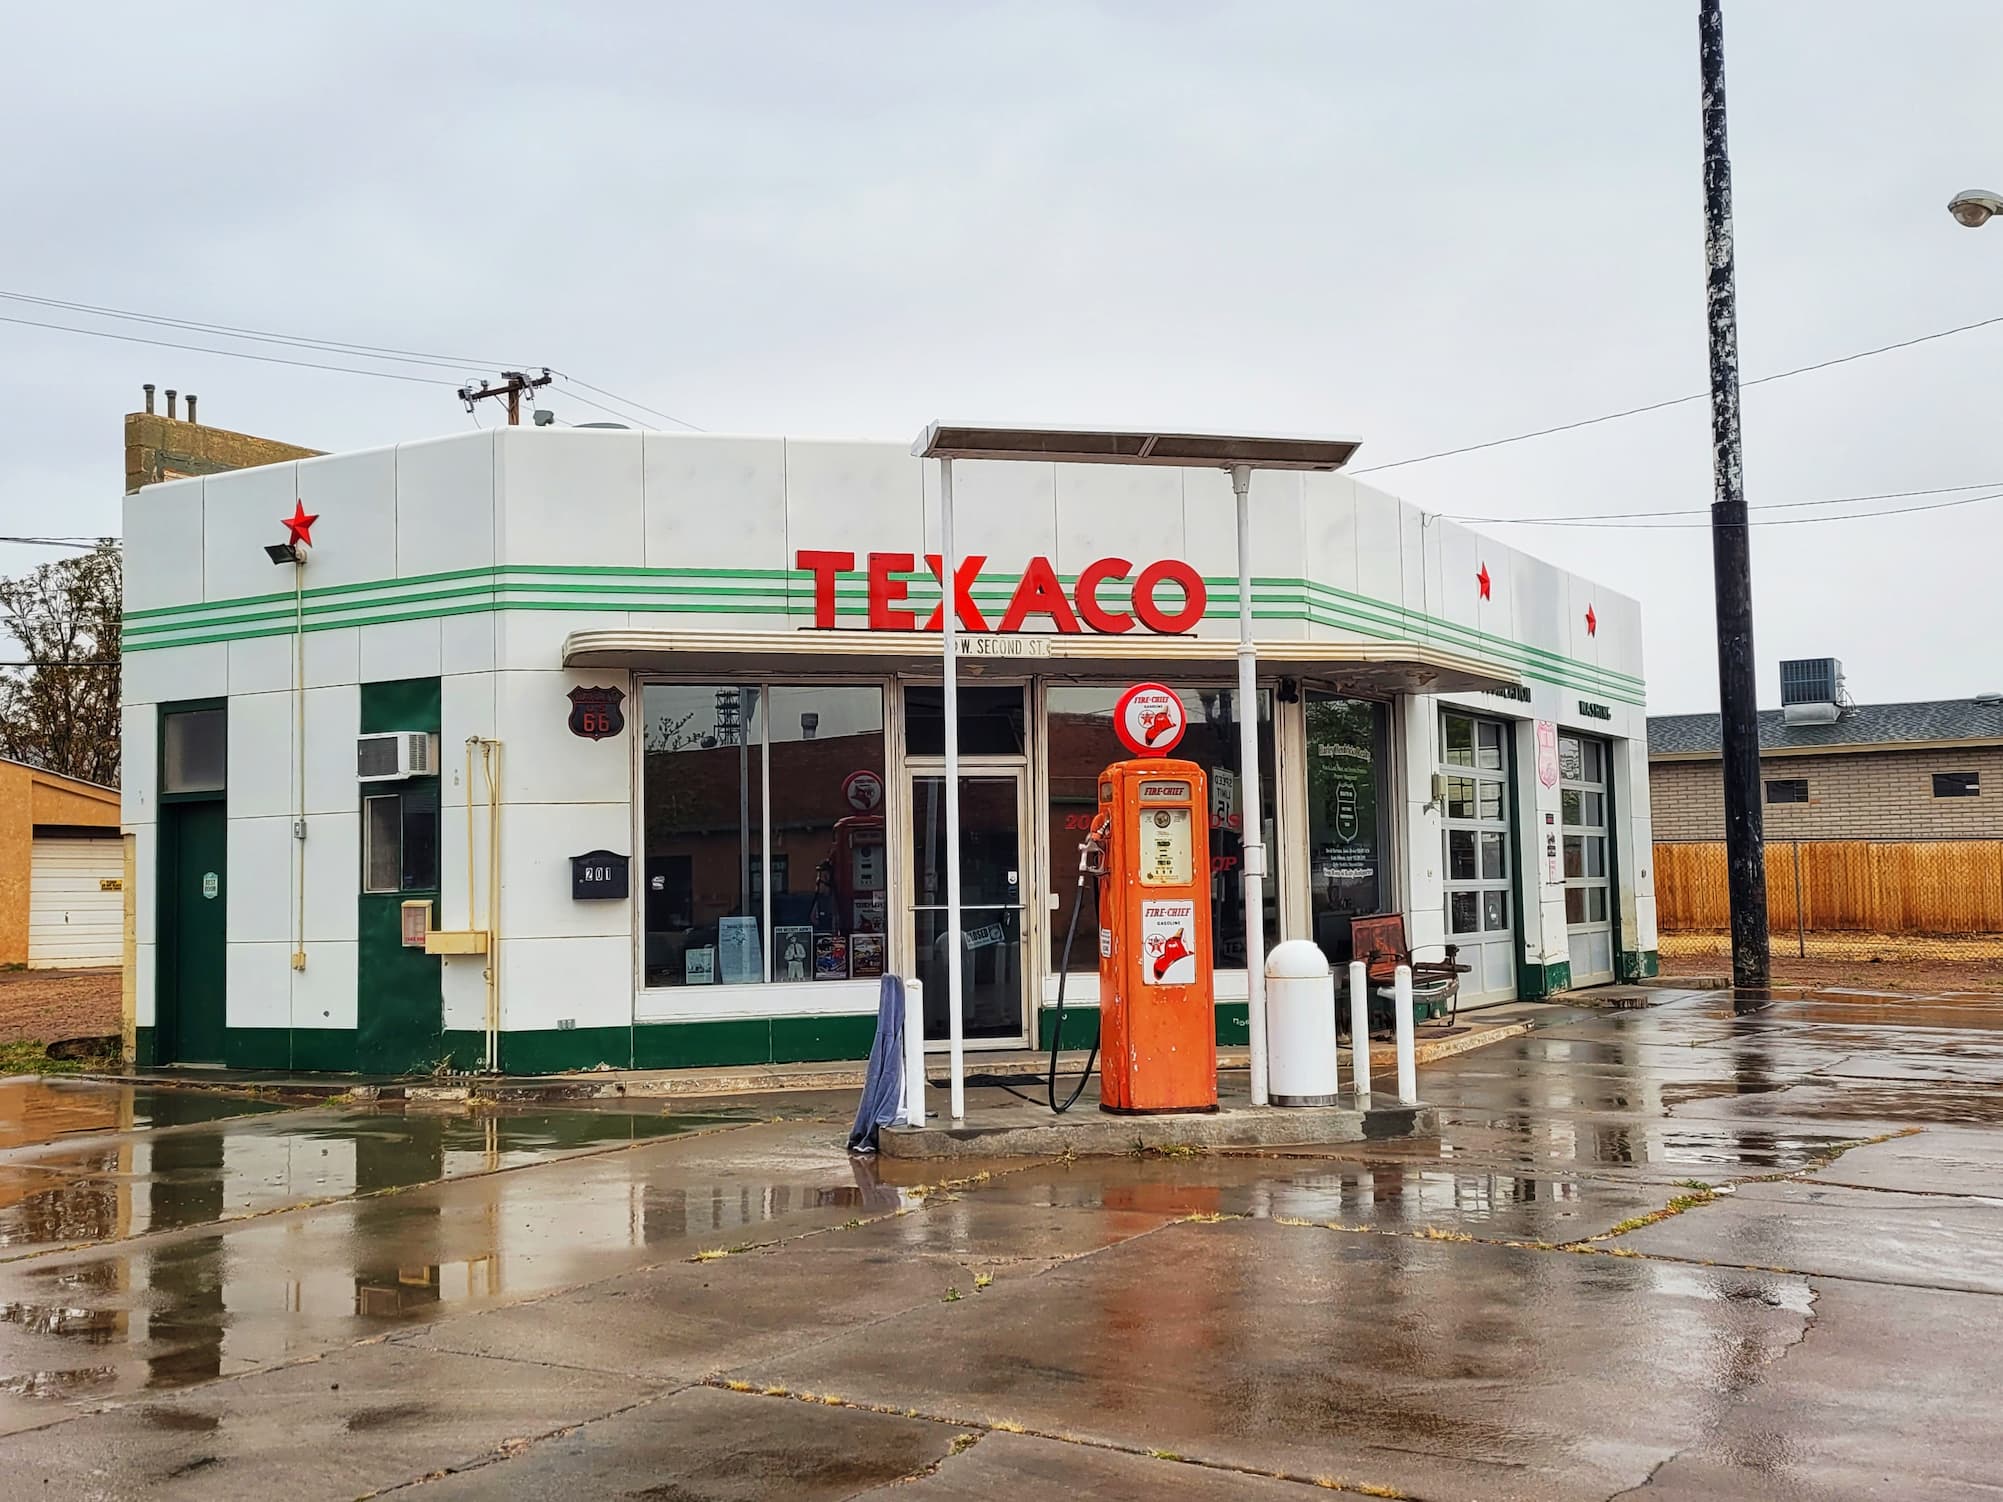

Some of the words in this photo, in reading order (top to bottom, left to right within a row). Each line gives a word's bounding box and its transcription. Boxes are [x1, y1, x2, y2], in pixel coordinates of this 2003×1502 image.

[796, 550, 1206, 634] TEXACO
[961, 640, 972, 654] W.
[977, 639, 1022, 655] SECOND
[584, 713, 608, 731] 66
[1144, 787, 1184, 796] FIRE-CHIEF
[585, 867, 611, 881] 201
[1145, 907, 1191, 917] FIRE-CHIEF
